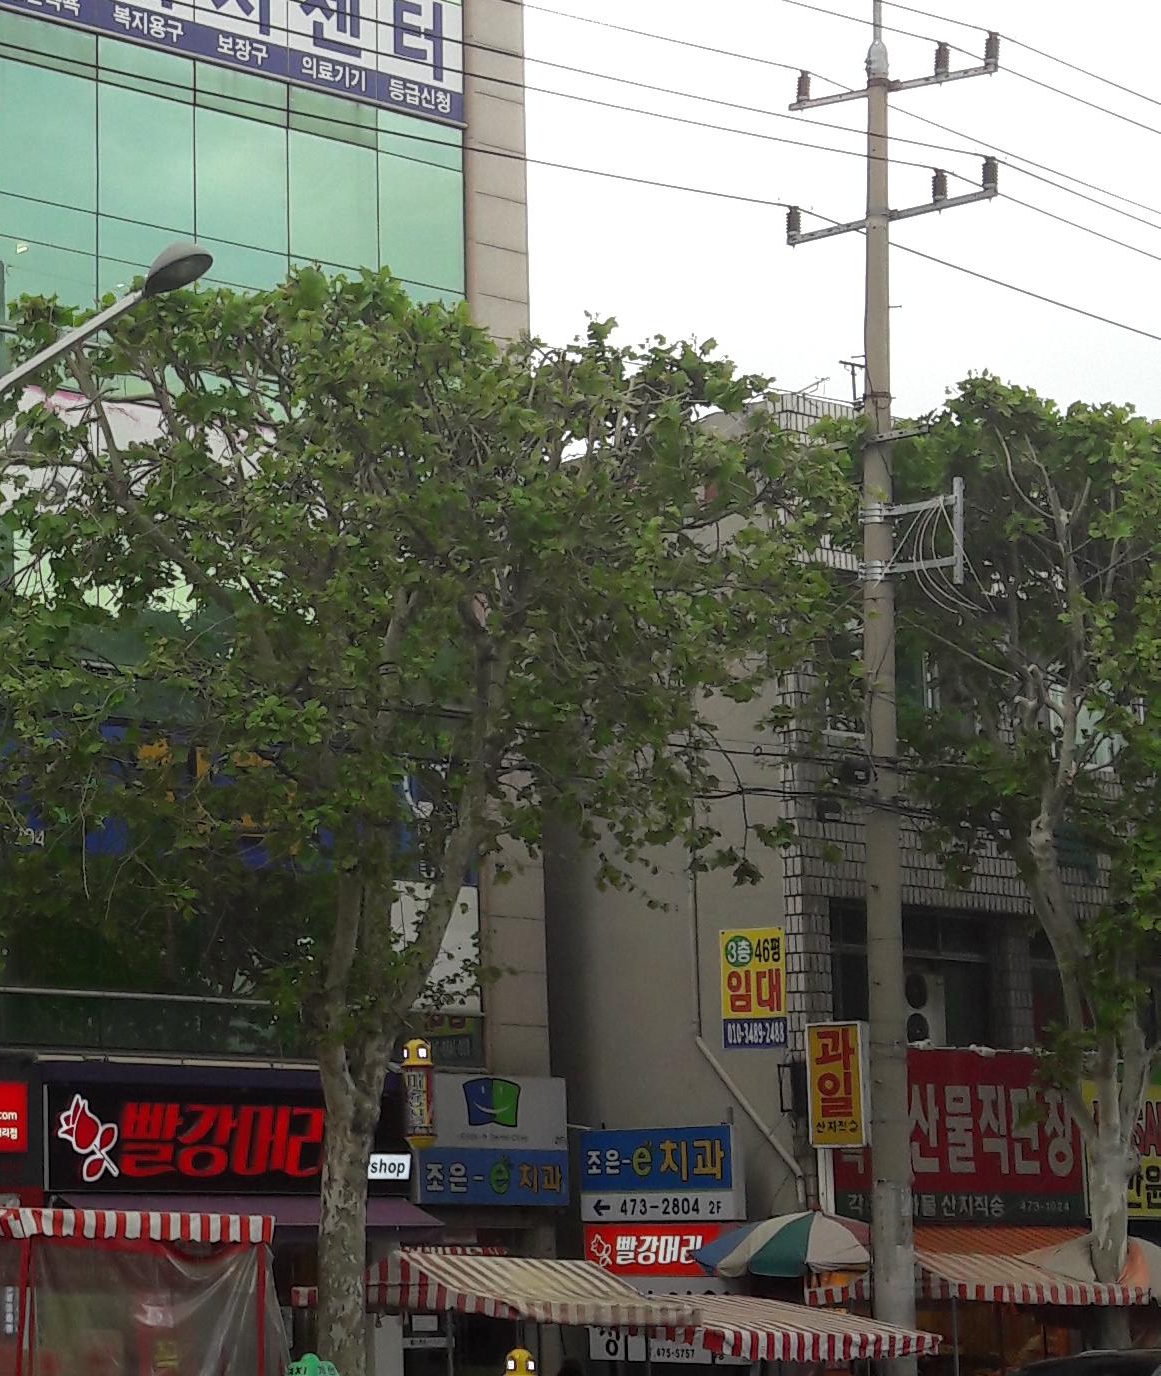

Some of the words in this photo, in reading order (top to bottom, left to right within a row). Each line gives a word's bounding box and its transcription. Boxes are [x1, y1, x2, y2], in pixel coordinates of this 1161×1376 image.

[113, 5, 185, 42] 복지용구
[216, 33, 269, 65] 보장구
[301, 55, 367, 91] 의료기기
[388, 78, 451, 113] 등급신청
[727, 938, 752, 965] 3층
[755, 937, 781, 963] 46평
[727, 968, 782, 1013] 임대
[815, 1027, 854, 1118] 과일
[369, 1159, 406, 1180] shop
[620, 1197, 700, 1215] 473-2804
[708, 1200, 722, 1214] 2F
[615, 1235, 703, 1265] 빨강머리
